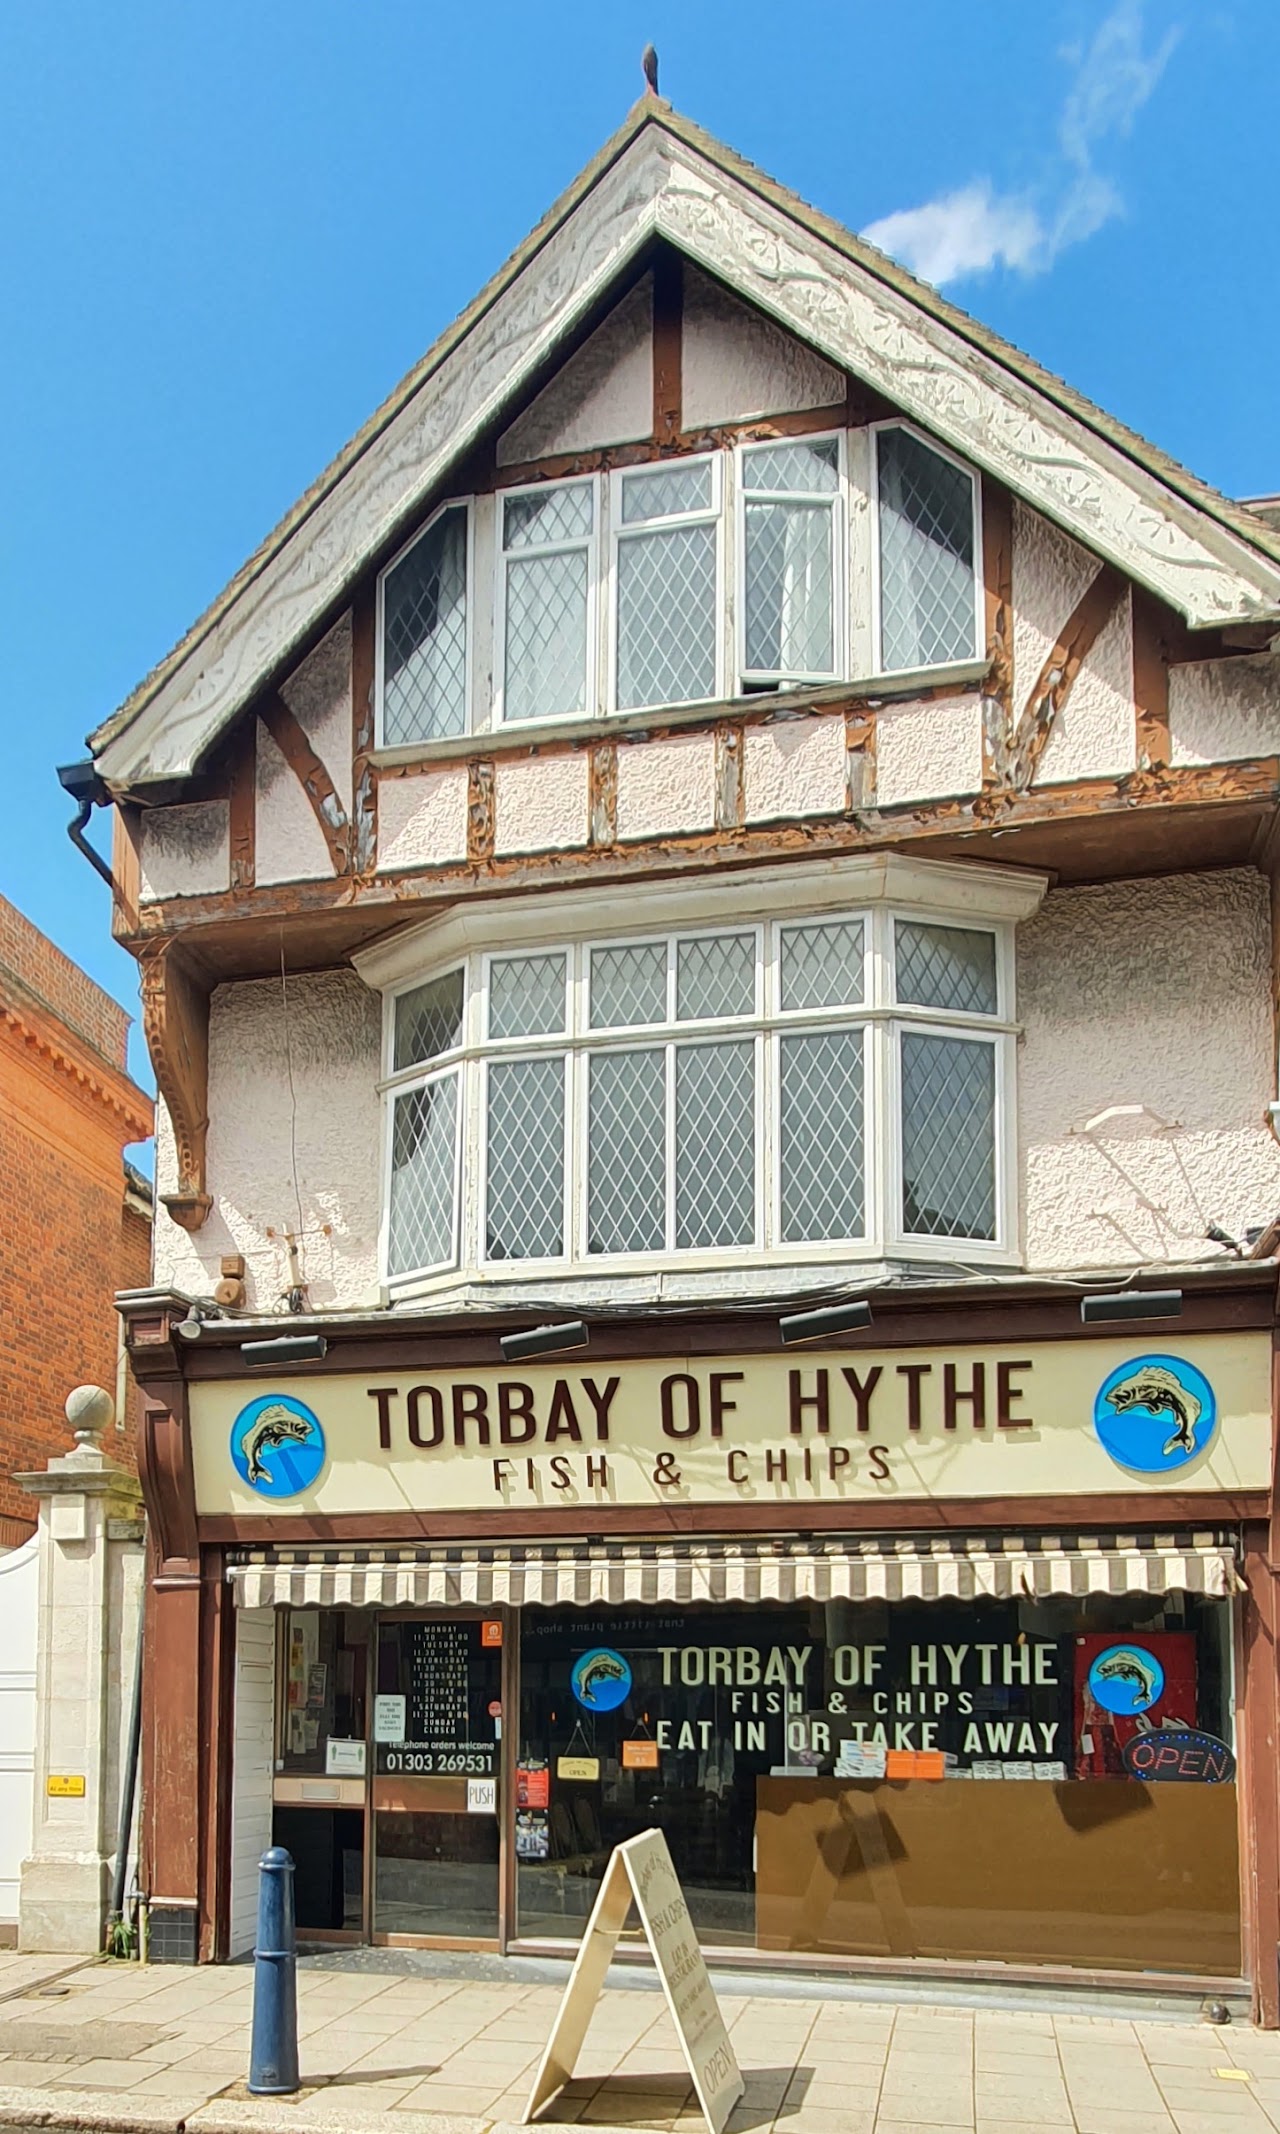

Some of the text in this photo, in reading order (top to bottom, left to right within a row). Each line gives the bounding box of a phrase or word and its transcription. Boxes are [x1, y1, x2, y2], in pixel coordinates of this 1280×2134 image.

[367, 1360, 1033, 1449] TORBAY OF HYTHE
[493, 1445, 890, 1490] FISH & CHIPS
[424, 1625, 457, 1633] MONDAY
[422, 1641, 459, 1649] TUESDAY
[416, 1656, 465, 1664] WEDNESDAY
[657, 1643, 1058, 1686] TORBAY OF HYTHE
[419, 1672, 461, 1680] THURSDAY
[425, 1687, 455, 1695] FRIDAY
[419, 1703, 461, 1711] SATURDAY
[732, 1692, 973, 1714] FISH & CHIPS
[423, 1718, 456, 1726] SUNDAY
[423, 1726, 456, 1734] CLOSED
[657, 1720, 1059, 1754] EAT IN OR TAKE AWAY
[430, 1740, 456, 1750] orders
[458, 1740, 495, 1751] welcome
[386, 1753, 493, 1772] 01303 269531
[1132, 1744, 1229, 1779] OPEN
[469, 1786, 494, 1805] PUSH
[704, 2041, 731, 2094] OPEN
